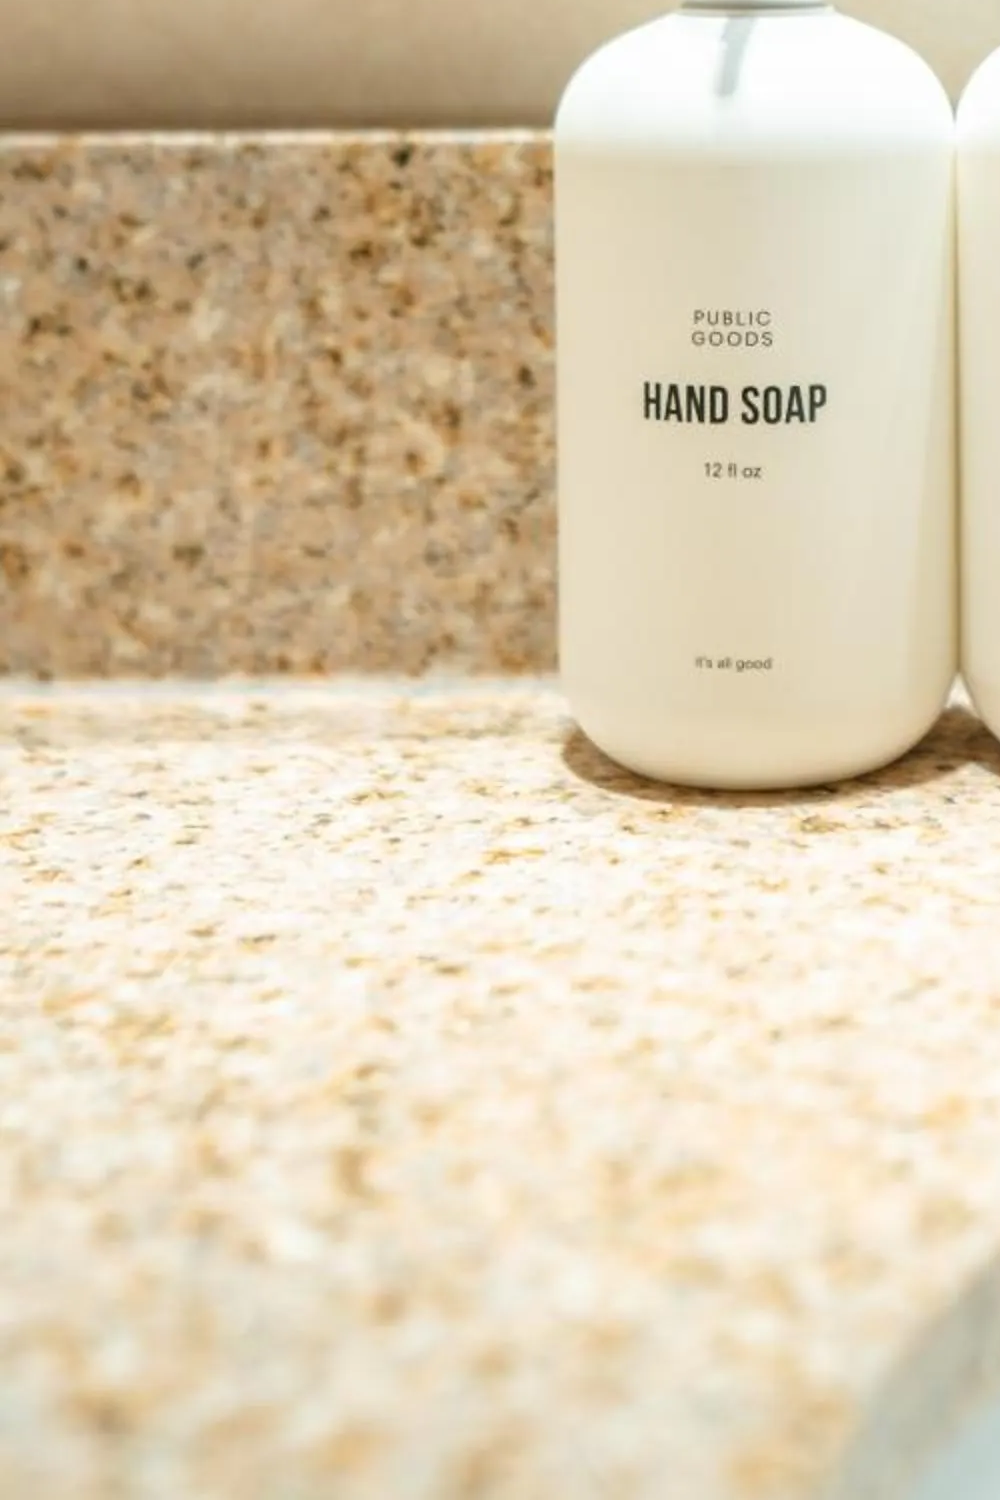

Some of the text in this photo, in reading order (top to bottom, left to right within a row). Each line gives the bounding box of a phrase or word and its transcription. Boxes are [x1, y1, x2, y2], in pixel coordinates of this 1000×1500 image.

[693, 309, 772, 327] PUBLIC
[691, 330, 774, 348] GOODS
[643, 380, 828, 426] HAND SOAP
[703, 462, 762, 479] 12 fl oz
[717, 657, 732, 671] all
[735, 657, 773, 673] good
